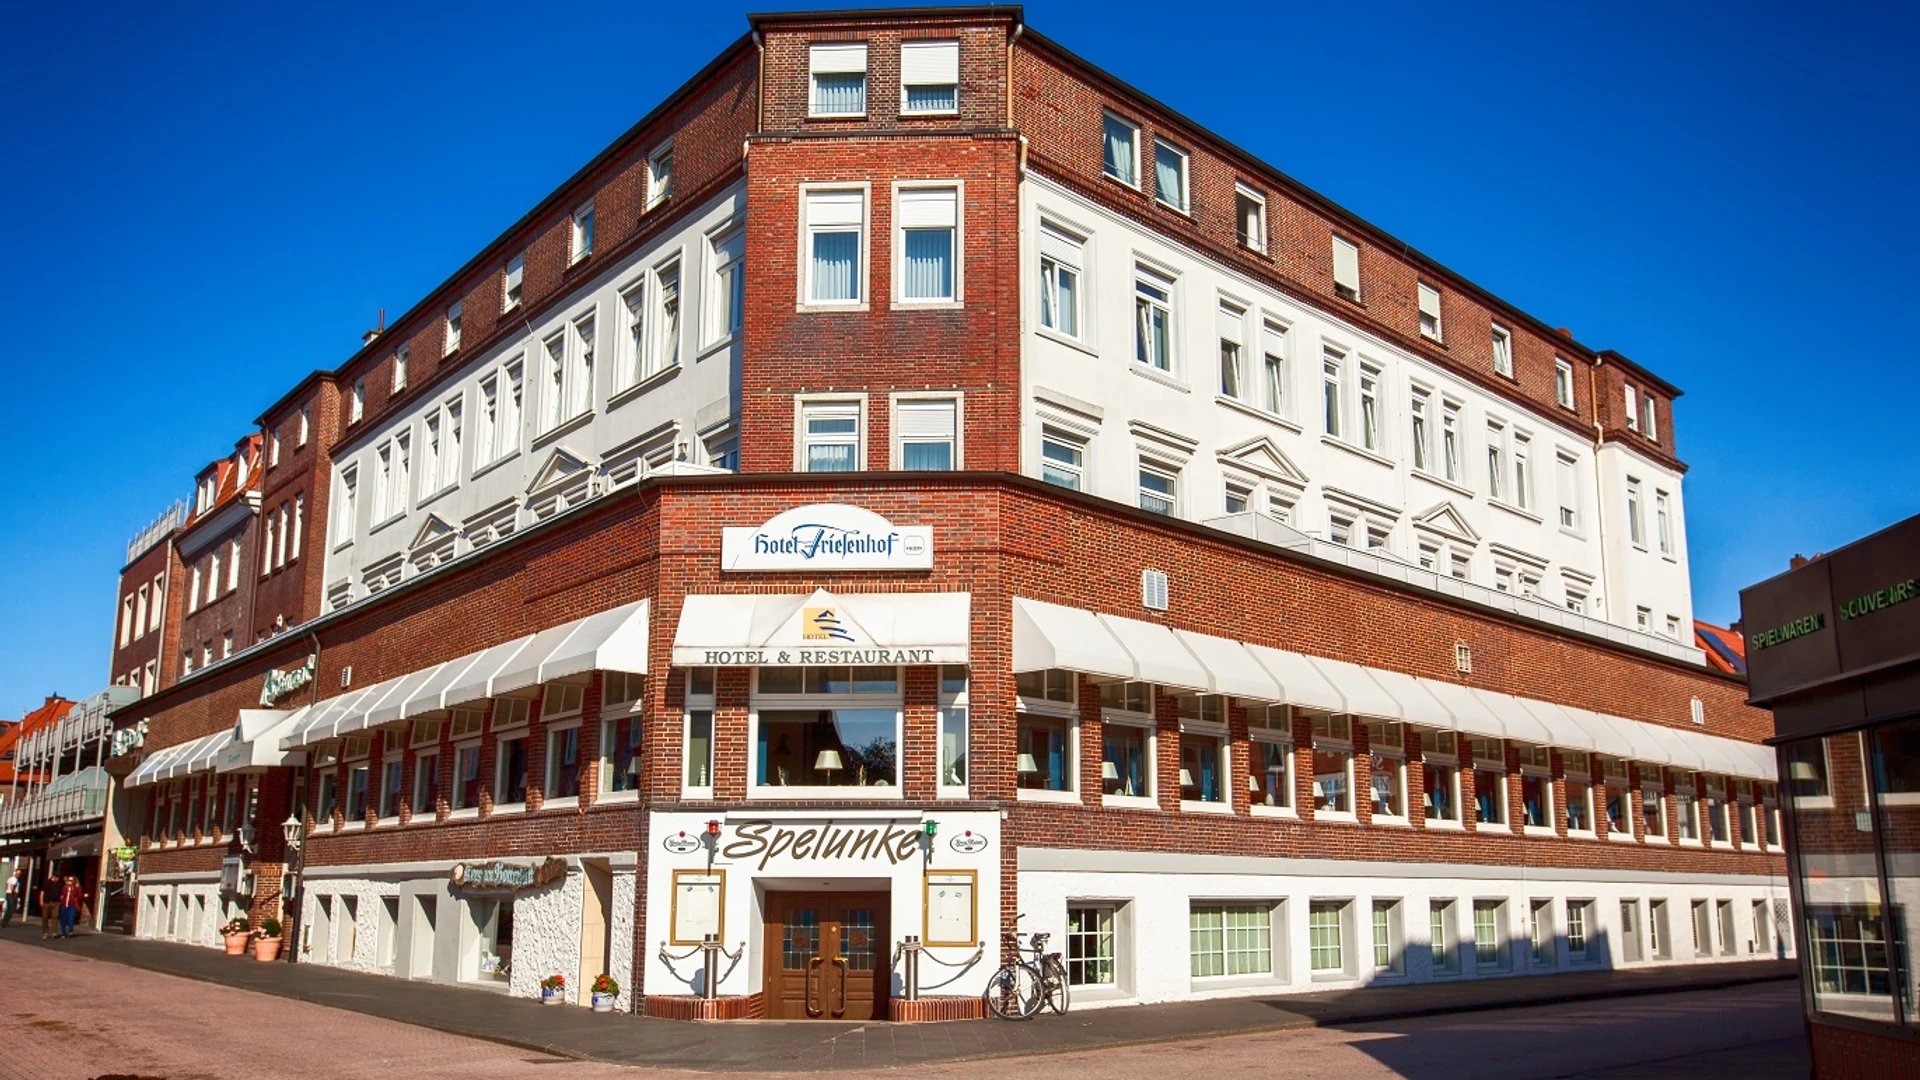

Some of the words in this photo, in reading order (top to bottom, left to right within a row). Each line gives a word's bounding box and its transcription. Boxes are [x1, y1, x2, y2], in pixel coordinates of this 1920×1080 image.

[755, 533, 798, 554] Hotel
[1840, 578, 1916, 620] SOUVENIRS
[1752, 613, 1820, 651] SPIELWAREN
[704, 651, 769, 665] HOTEL
[777, 651, 791, 664] &
[799, 649, 934, 664] RESTAURANT
[723, 818, 922, 871] Spelunke
